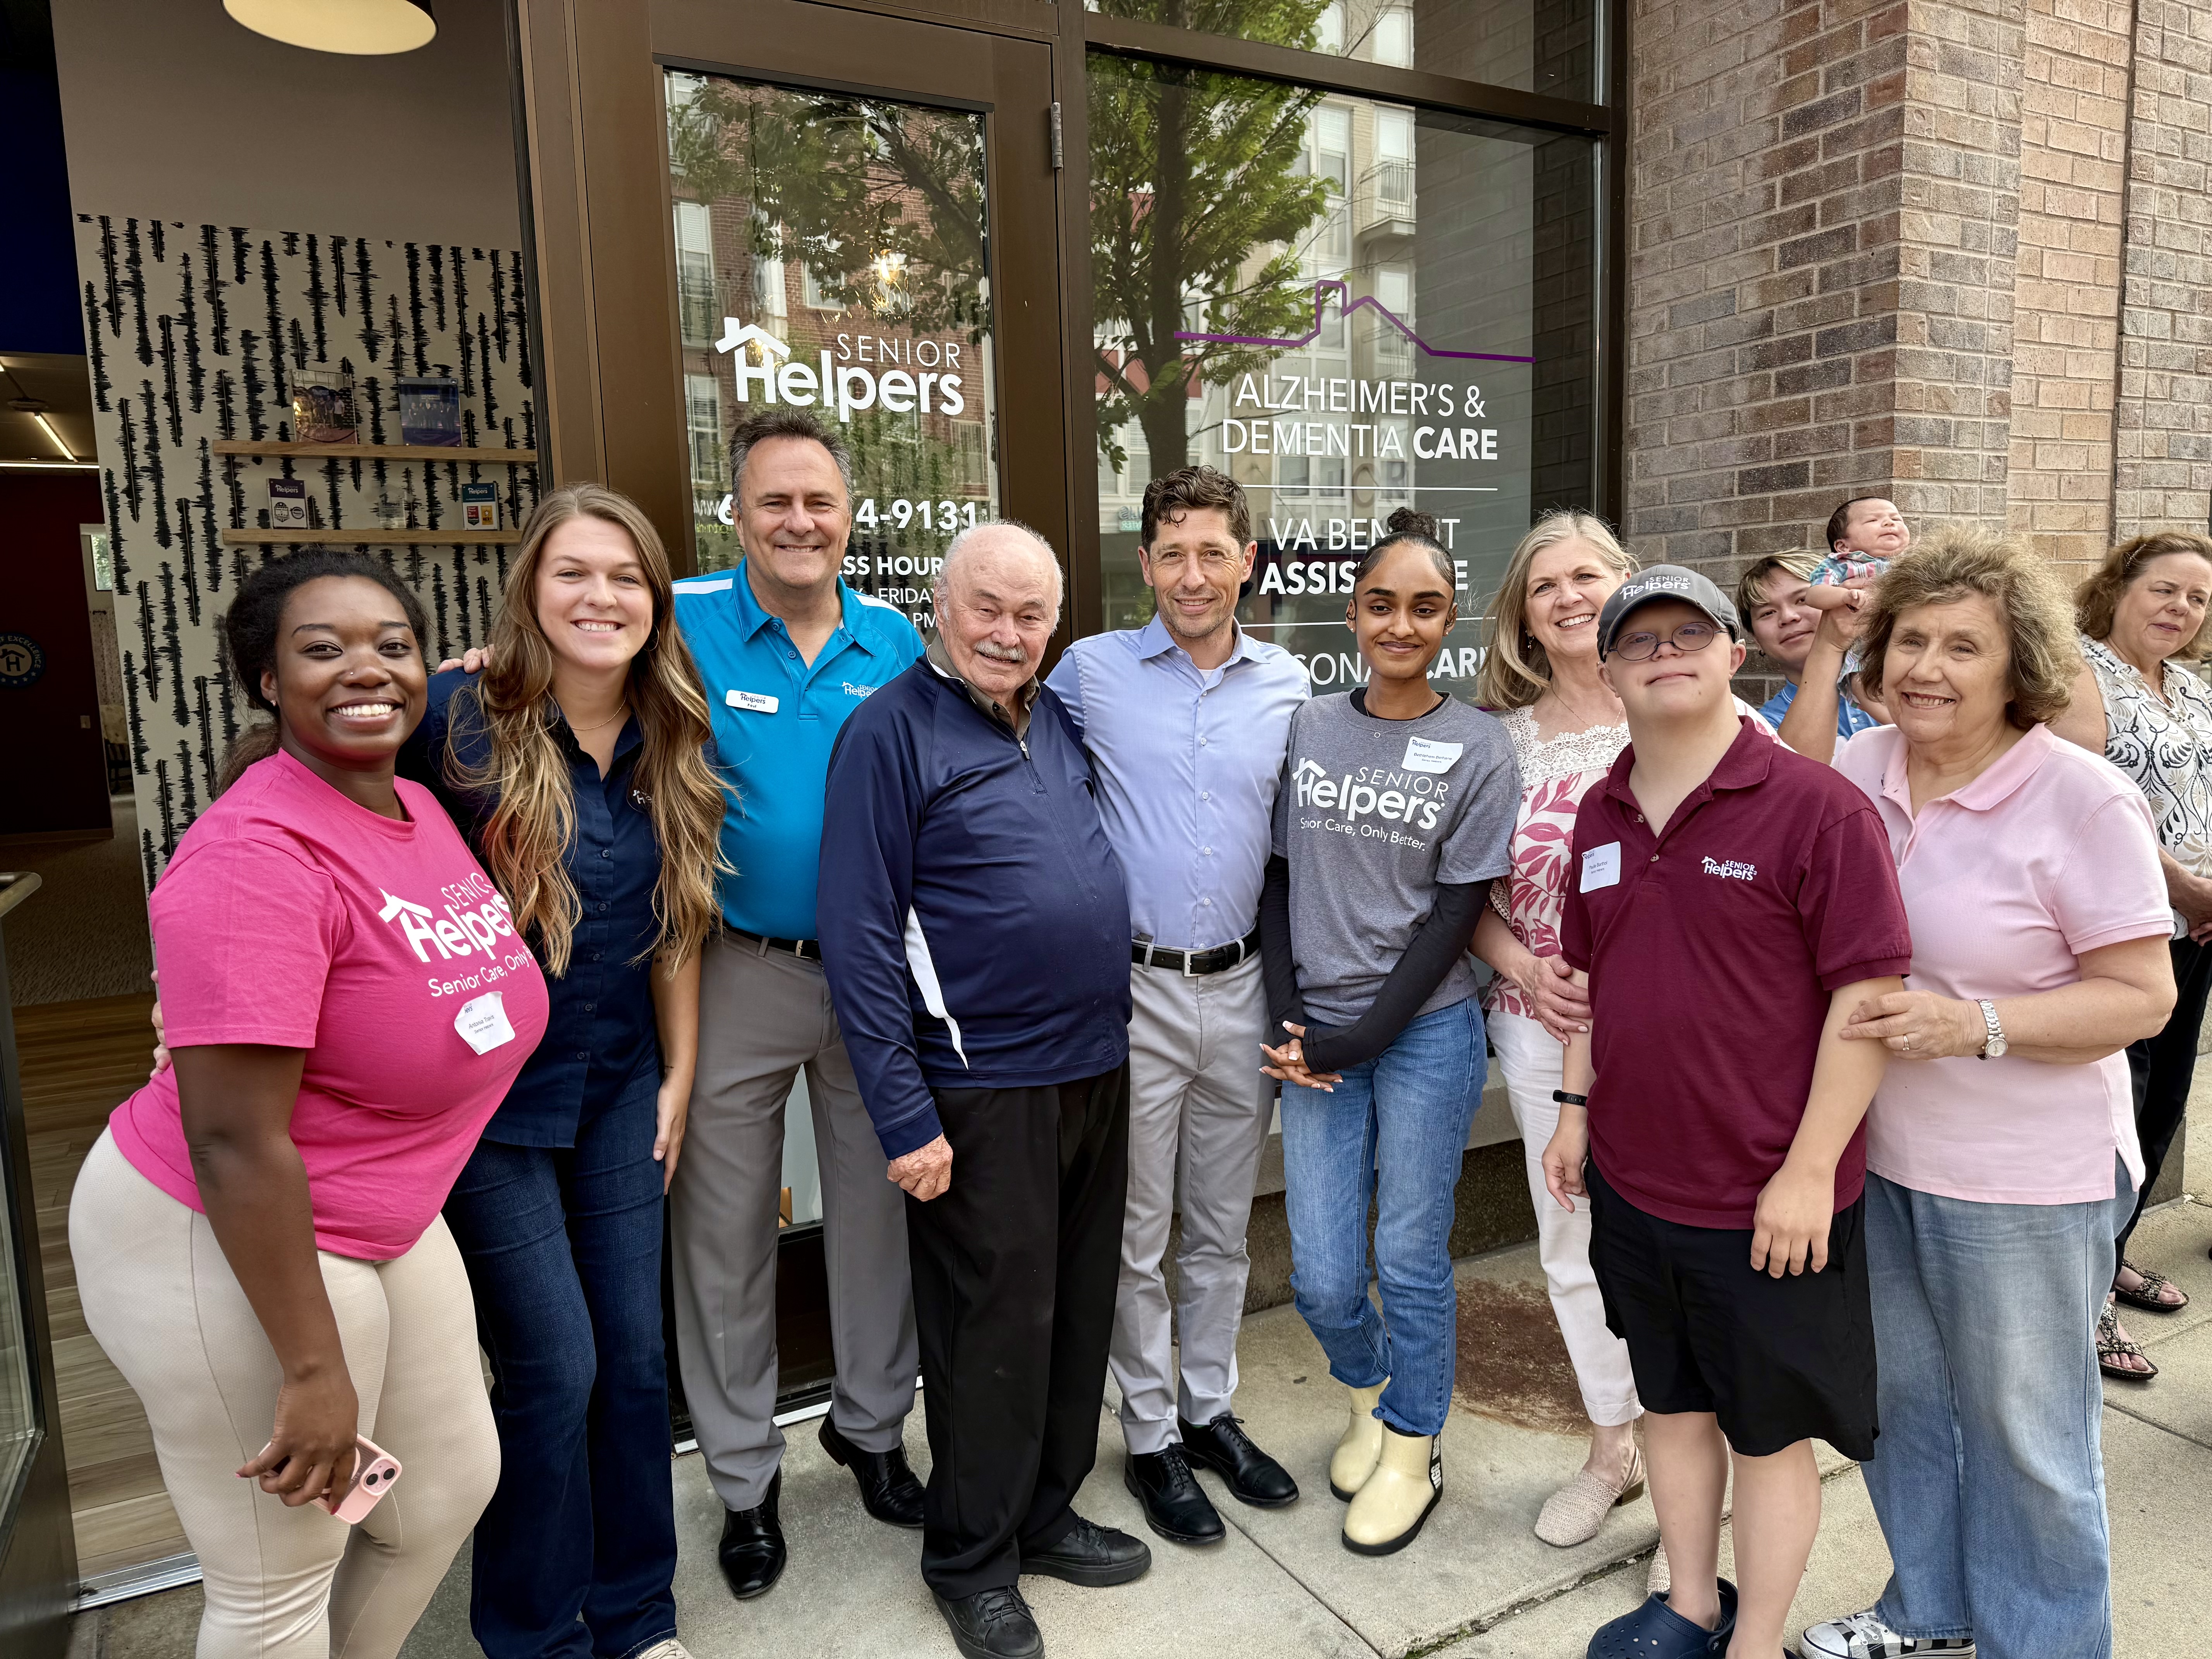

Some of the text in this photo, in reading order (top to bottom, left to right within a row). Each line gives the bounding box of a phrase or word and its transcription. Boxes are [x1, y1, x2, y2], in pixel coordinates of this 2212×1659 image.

[836, 333, 961, 369] SENIOR
[734, 346, 965, 423] Helpers
[1235, 373, 1486, 418] ALZHEIMER'S &
[1222, 418, 1498, 460] DEMENTIA CARE
[1269, 518, 1318, 550] VA
[877, 556, 944, 575] HOUR
[878, 588, 935, 604] FRIDA
[1623, 580, 1689, 601] Helpers
[741, 695, 766, 704] Helpers
[1355, 767, 1449, 800] SENIOR
[1297, 772, 1441, 830] Helpers
[1325, 818, 1356, 836] Care,
[1360, 824, 1388, 842] Only
[1390, 831, 1425, 851] Better.
[1704, 862, 1753, 881] Helpers
[1725, 860, 1755, 871] SENIOR
[399, 894, 515, 963] Helpers
[428, 973, 481, 997] Senior
[480, 965, 508, 982] Care,
[505, 949, 529, 970] Only
[1431, 1462, 1441, 1489] UGG
